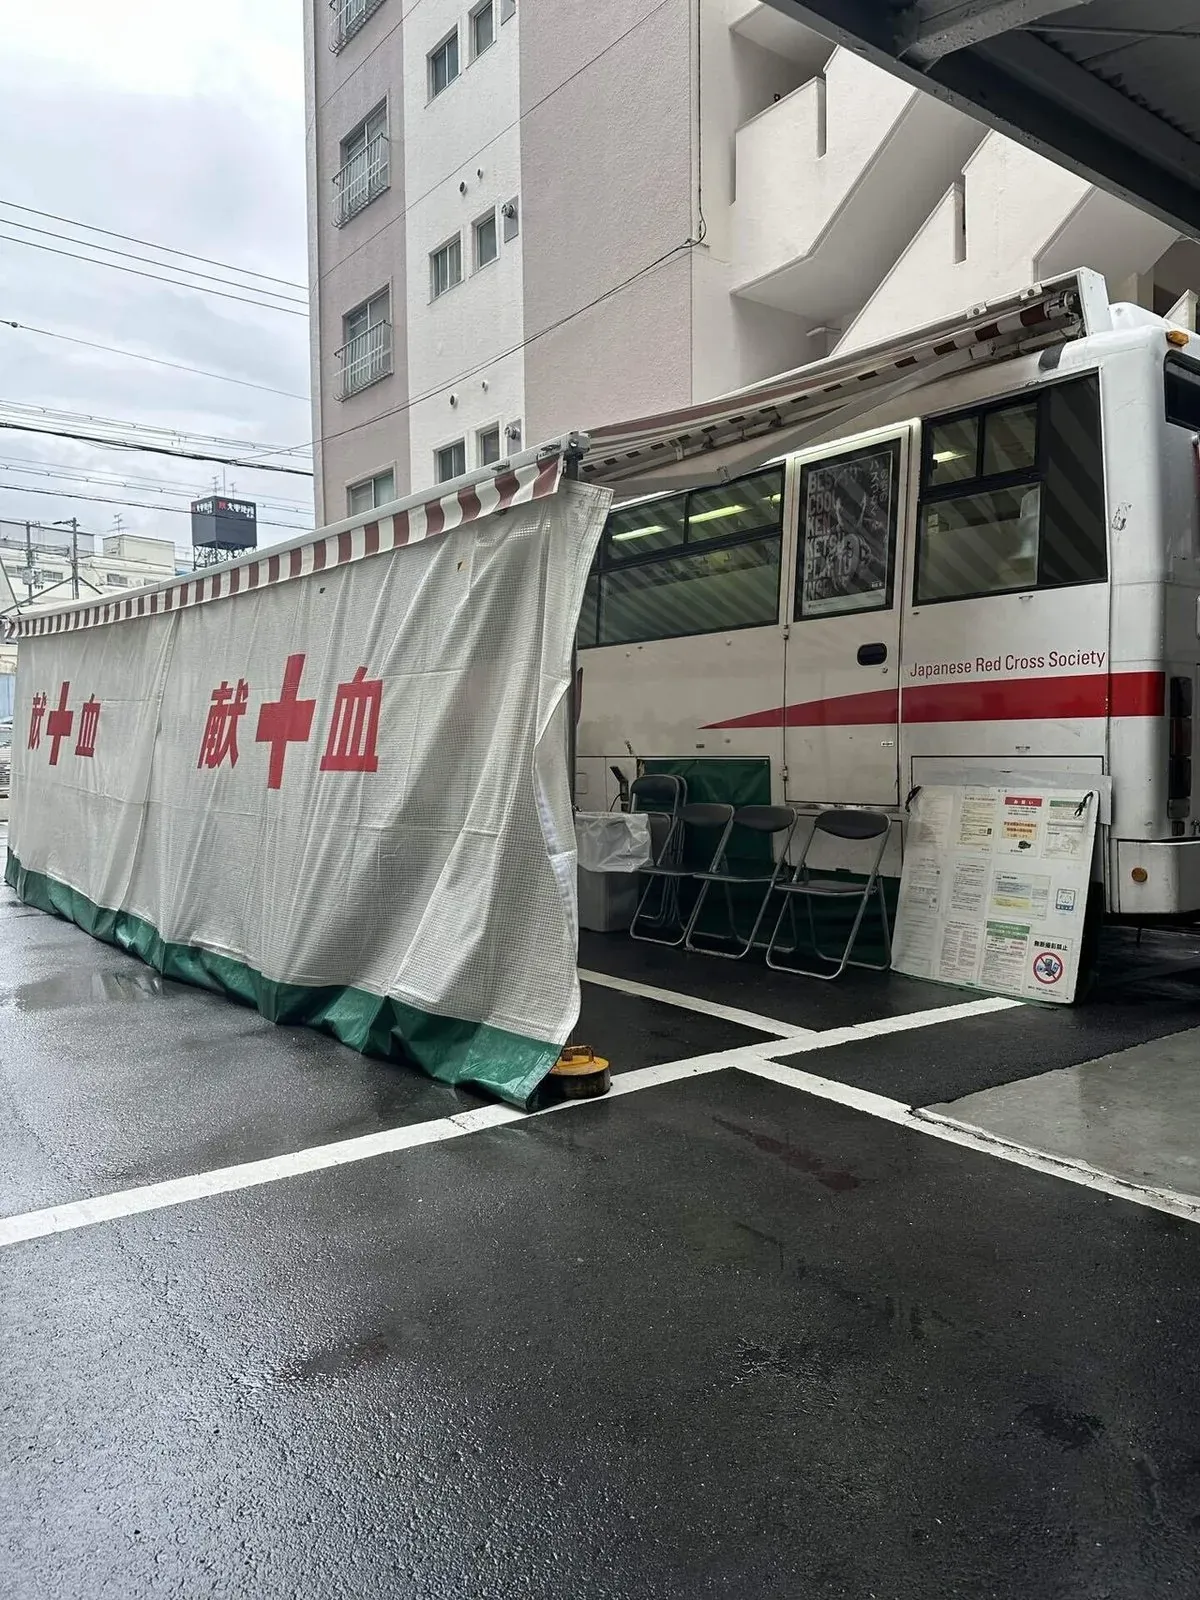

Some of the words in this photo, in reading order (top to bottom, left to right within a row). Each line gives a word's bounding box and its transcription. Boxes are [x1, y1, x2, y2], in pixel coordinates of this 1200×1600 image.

[910, 660, 972, 678] Japanese
[976, 656, 1001, 672] Red
[1005, 654, 1045, 671] Cross
[1049, 650, 1106, 668] Society
